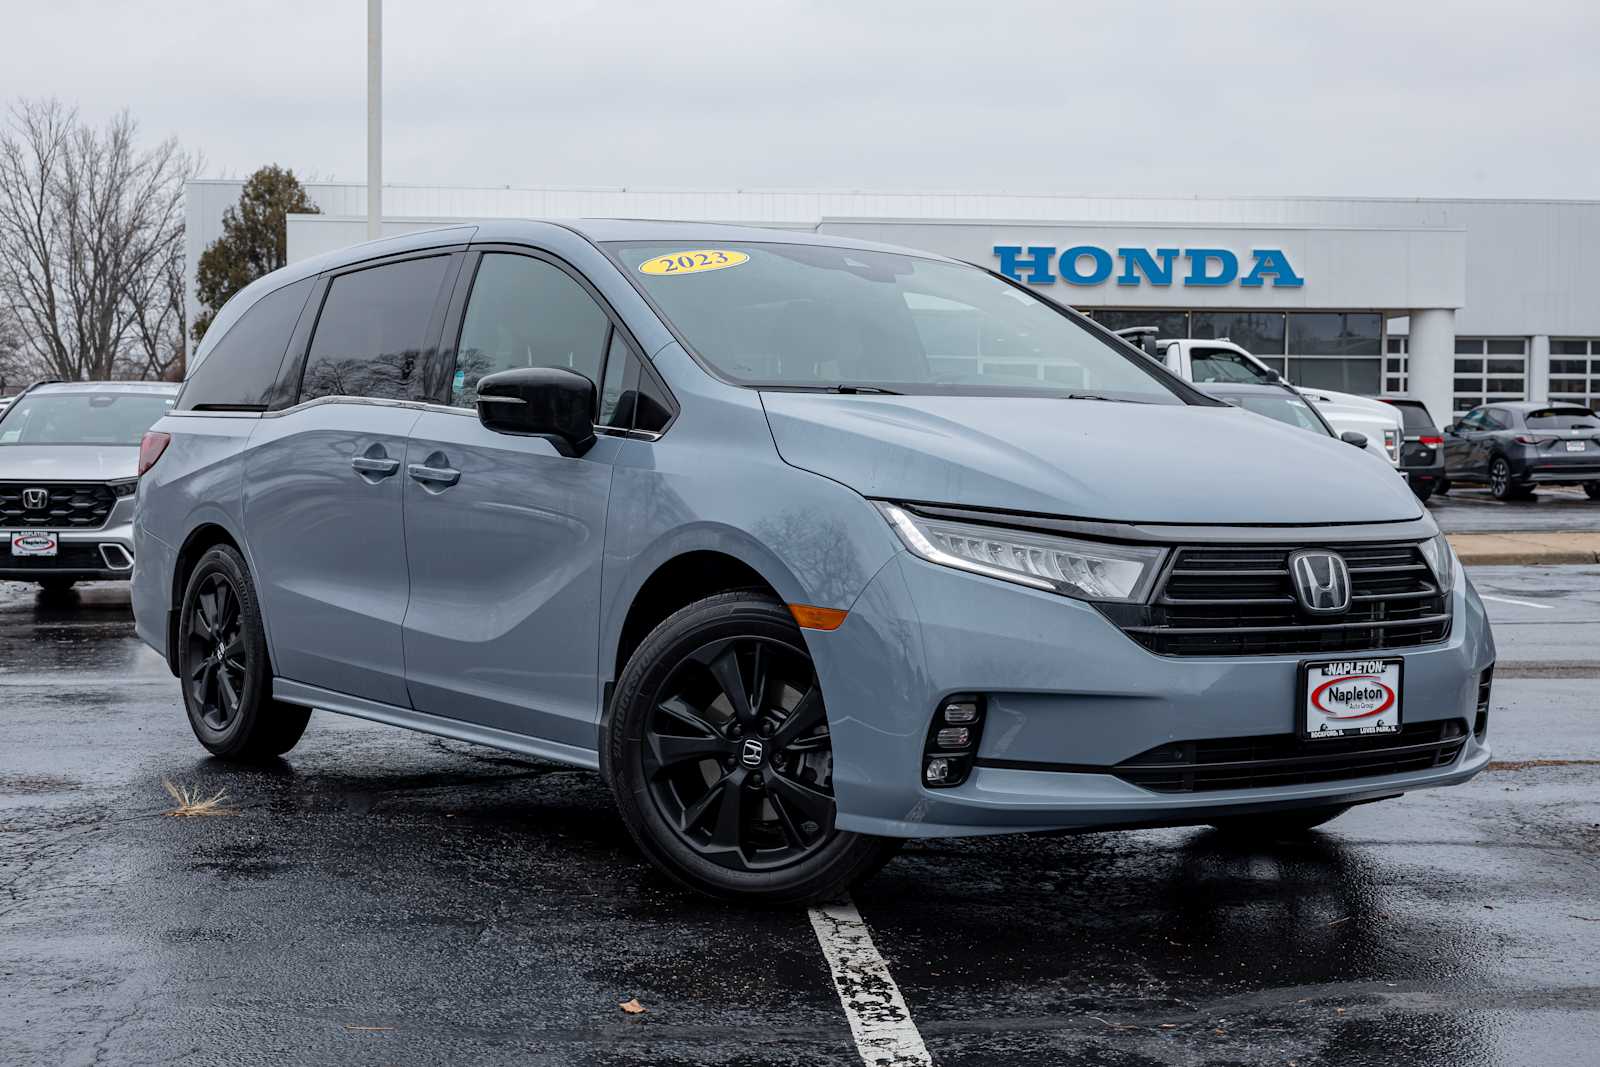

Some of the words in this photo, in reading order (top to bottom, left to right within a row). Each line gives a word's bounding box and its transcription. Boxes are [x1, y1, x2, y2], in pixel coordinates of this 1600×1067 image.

[659, 252, 728, 272] 2023
[993, 246, 1304, 288] HONDA
[1328, 661, 1383, 675] NAPLETON
[611, 641, 661, 759] BRIDGESTO
[1328, 685, 1383, 704] Napleton
